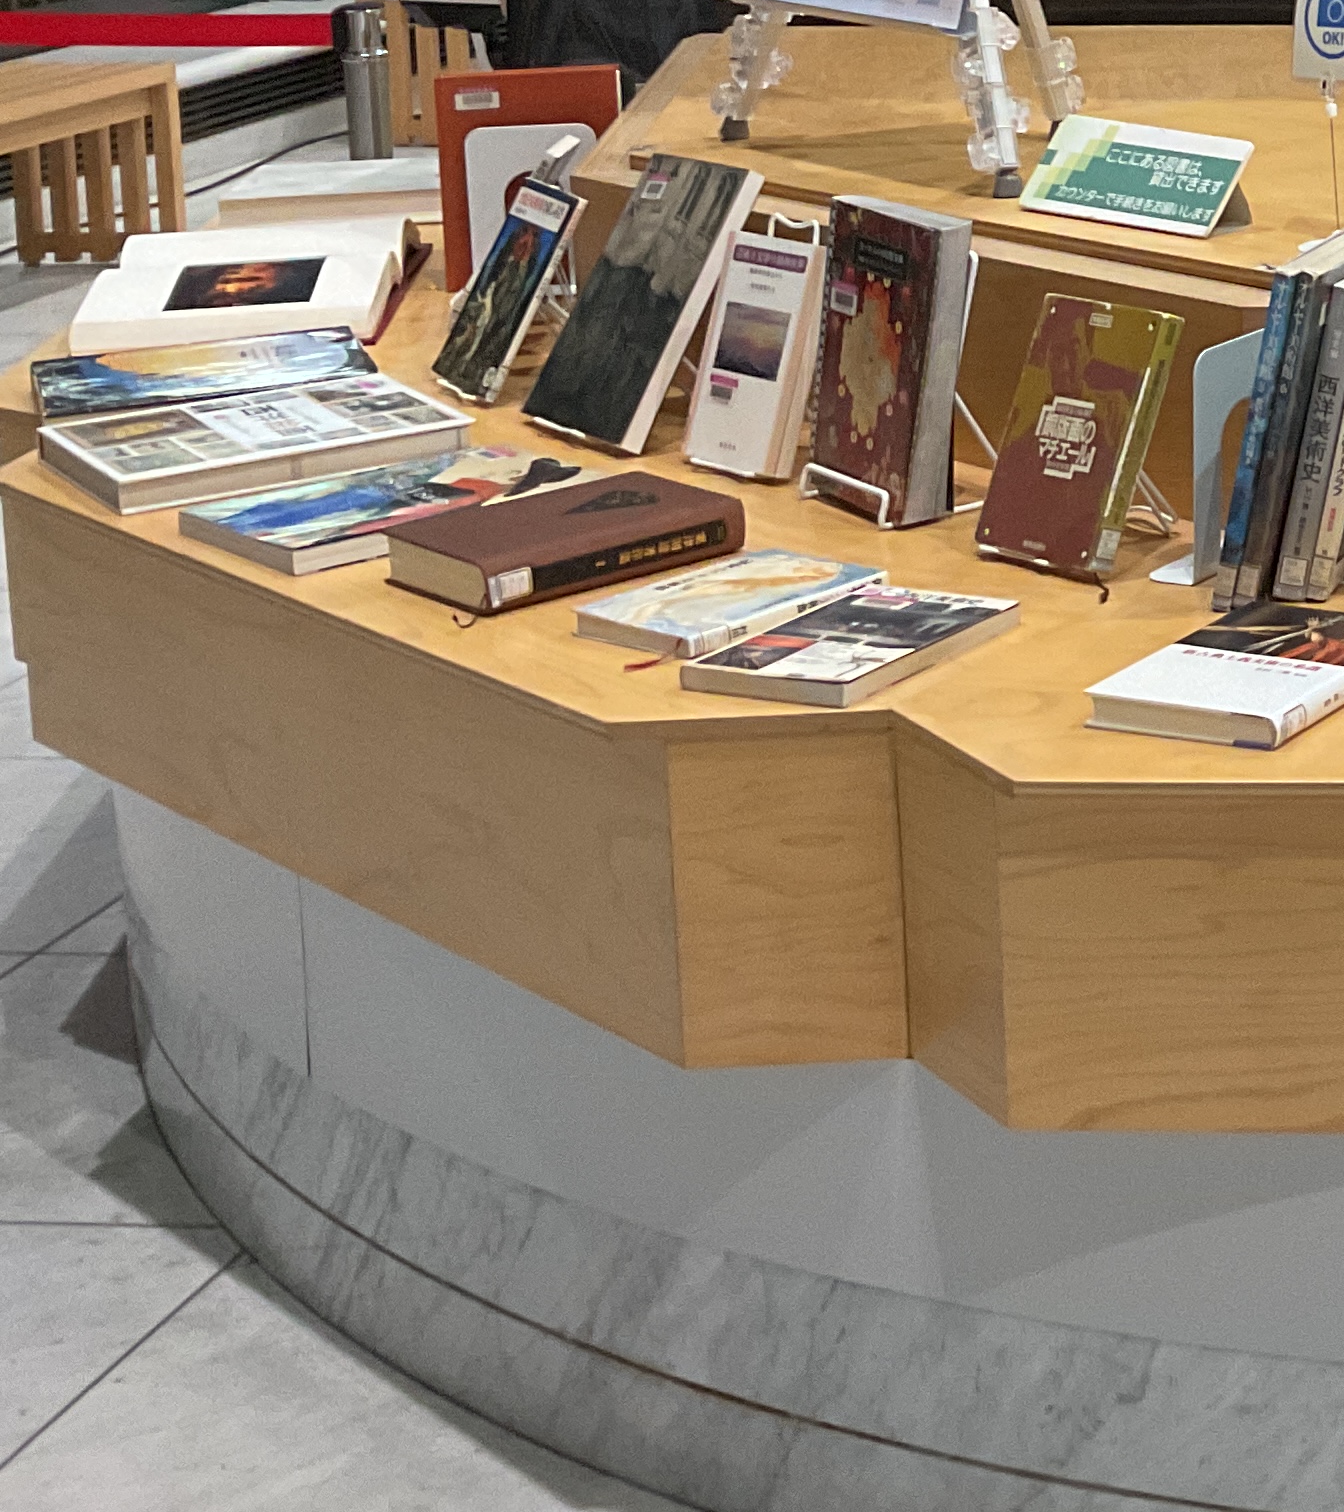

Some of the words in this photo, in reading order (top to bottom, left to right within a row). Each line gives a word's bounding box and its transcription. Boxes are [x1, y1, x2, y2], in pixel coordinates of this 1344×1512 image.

[1322, 31, 1344, 46] OK!
[1149, 172, 1225, 196] 貸出できます
[1302, 374, 1340, 484] 西洋美術史
